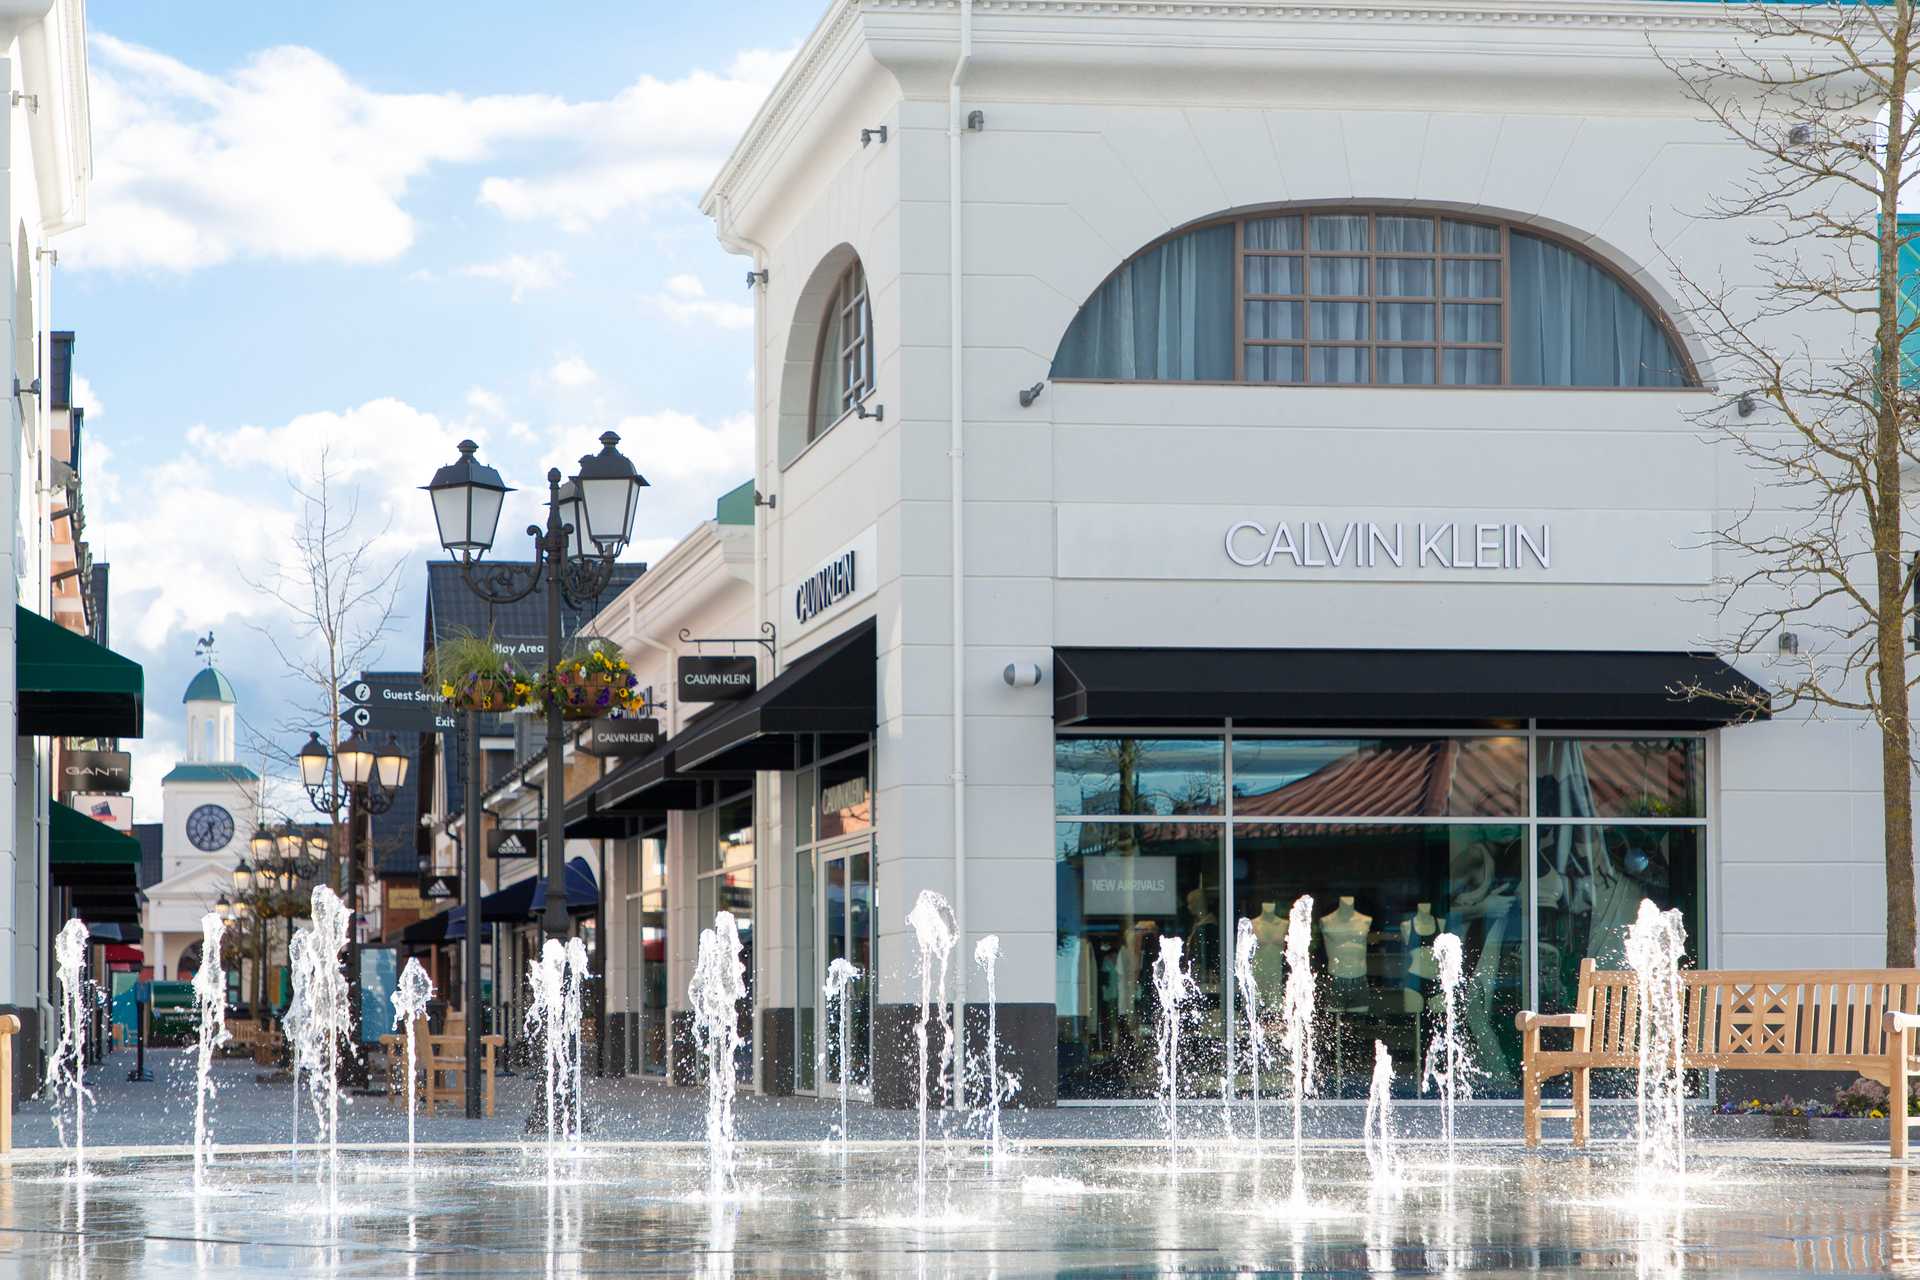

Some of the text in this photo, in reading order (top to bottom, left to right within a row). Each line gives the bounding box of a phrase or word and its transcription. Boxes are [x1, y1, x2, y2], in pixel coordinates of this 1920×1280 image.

[1224, 519, 1551, 569] CALVIN KLEIN
[518, 643, 544, 653] Area
[684, 673, 751, 685] CALVIN KLEIN
[382, 689, 413, 701] Guest
[435, 716, 455, 728] Exit
[597, 732, 654, 743] CALVIN KLEIN
[65, 766, 124, 777] GANT
[1092, 879, 1166, 892] NEW ARRIVALS
